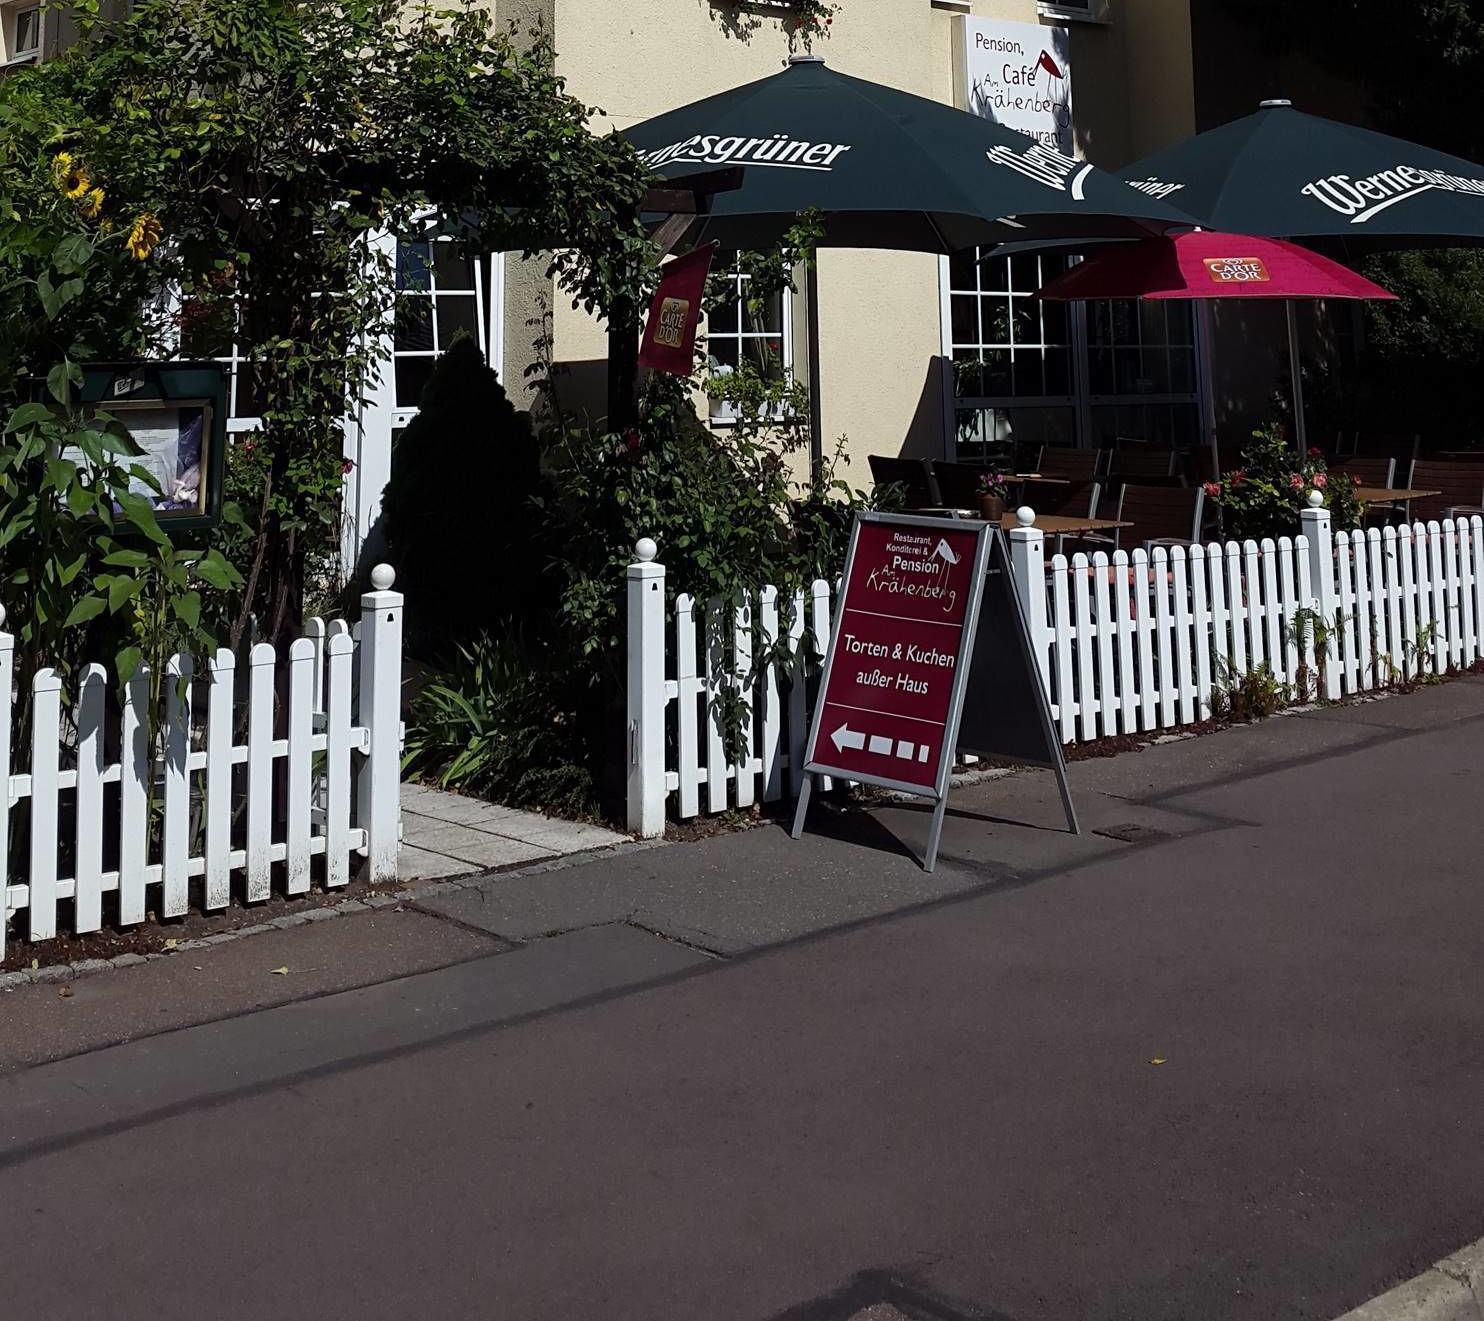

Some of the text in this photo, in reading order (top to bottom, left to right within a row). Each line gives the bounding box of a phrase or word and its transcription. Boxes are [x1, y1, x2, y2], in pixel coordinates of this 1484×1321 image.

[975, 32, 1025, 56] Pension,
[1003, 64, 1036, 87] Café
[971, 73, 1070, 128] Am Krähenberg
[1210, 263, 1261, 273] CARTE
[660, 309, 685, 328] CARTE
[886, 543, 922, 555] Konditorei
[893, 533, 932, 546] Restaurant,
[893, 556, 939, 574] Pension
[866, 568, 956, 612] Krähenberg
[844, 634, 955, 668] Torten & Kuchen
[856, 669, 929, 695] außer Haus
